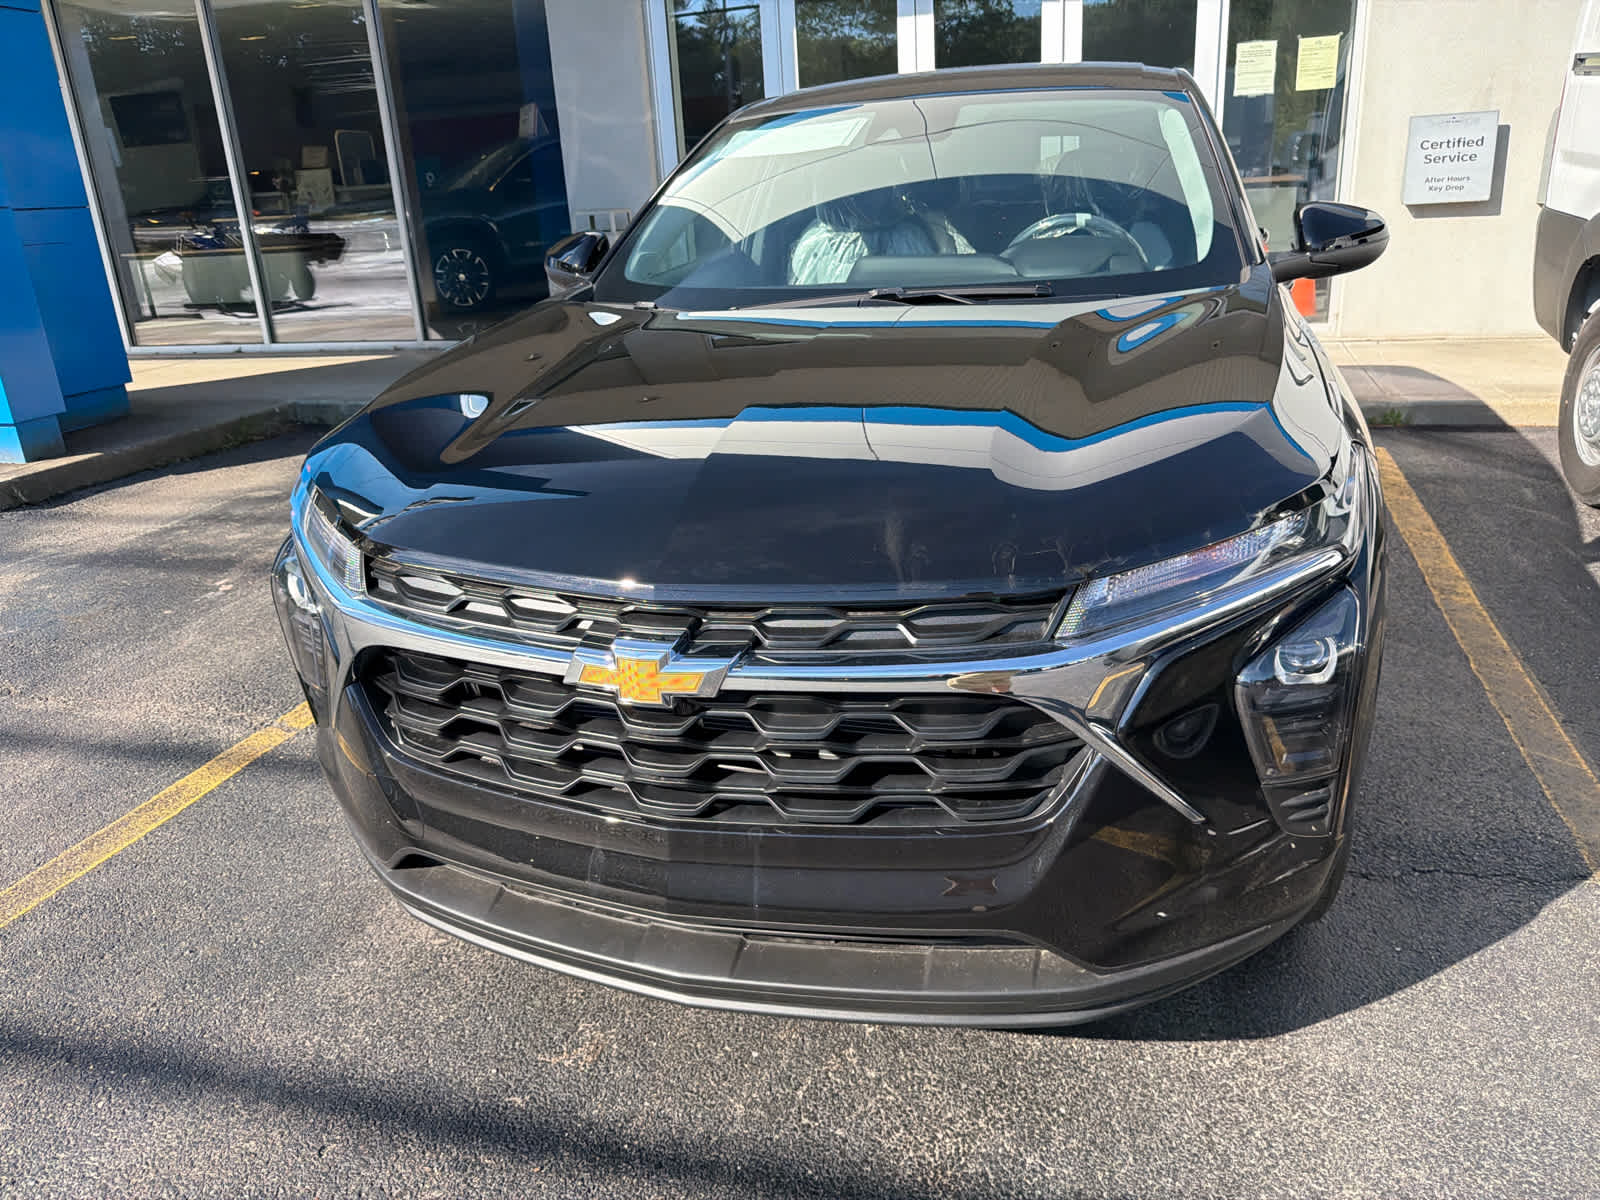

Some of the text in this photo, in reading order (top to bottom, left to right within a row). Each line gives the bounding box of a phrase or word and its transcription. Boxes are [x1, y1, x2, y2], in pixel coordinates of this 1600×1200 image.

[1420, 136, 1485, 150] Certified
[1423, 152, 1478, 164] Service
[1425, 176, 1445, 184] After
[1428, 184, 1465, 193] Key Drop
